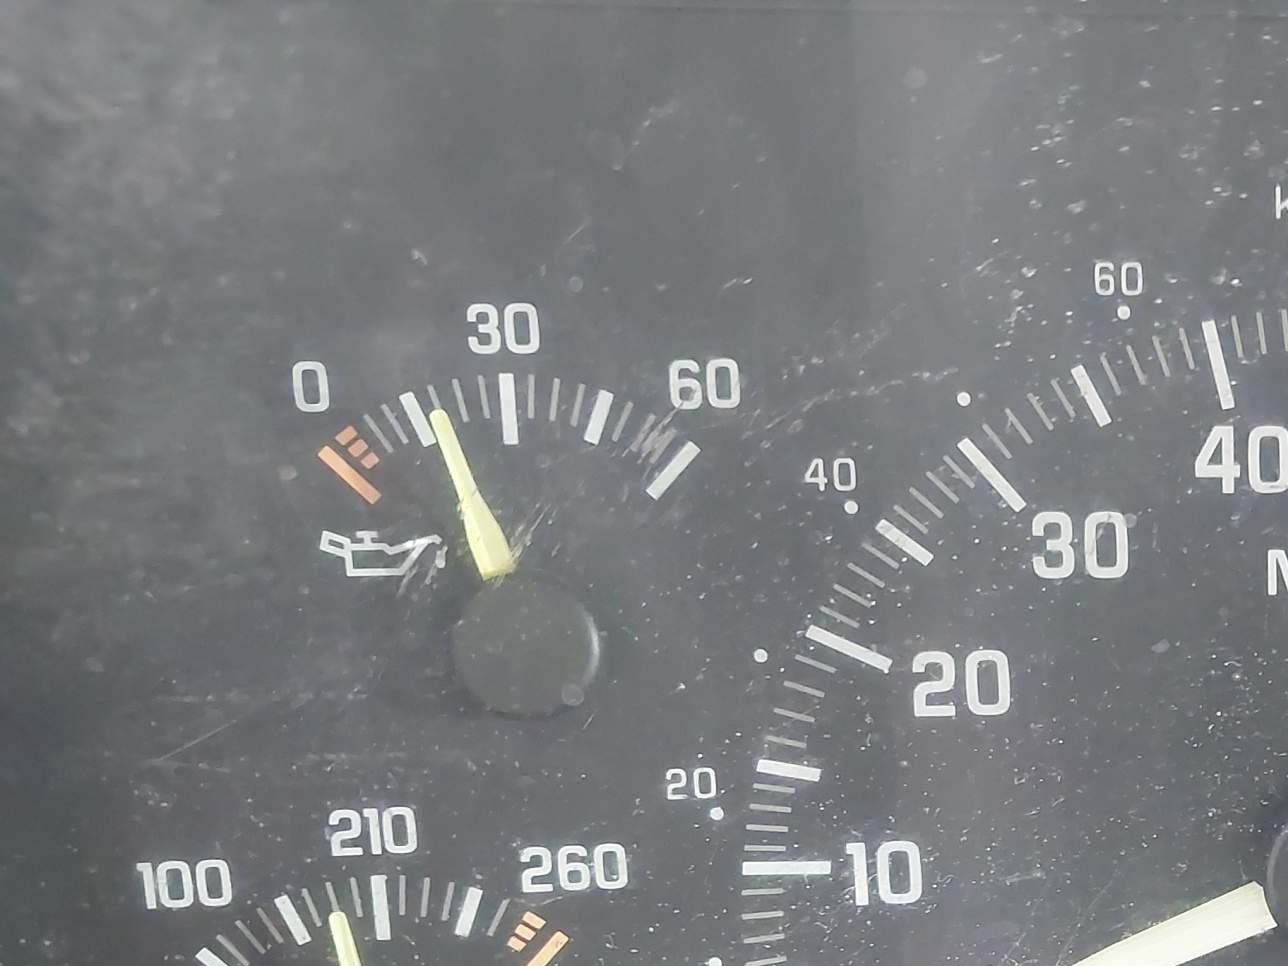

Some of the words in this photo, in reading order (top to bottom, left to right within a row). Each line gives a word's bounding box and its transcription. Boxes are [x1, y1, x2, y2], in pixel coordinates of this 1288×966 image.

[1093, 261, 1144, 297] 60
[466, 303, 541, 354] 30
[291, 361, 330, 413] 0
[669, 358, 741, 409] 60
[804, 457, 857, 492] 40
[1031, 511, 1130, 579] 30
[911, 650, 1011, 718] 20
[665, 768, 718, 800] 20
[329, 807, 418, 857] 210
[137, 858, 232, 909] 100
[520, 843, 628, 893] 260
[845, 840, 923, 906] 10
